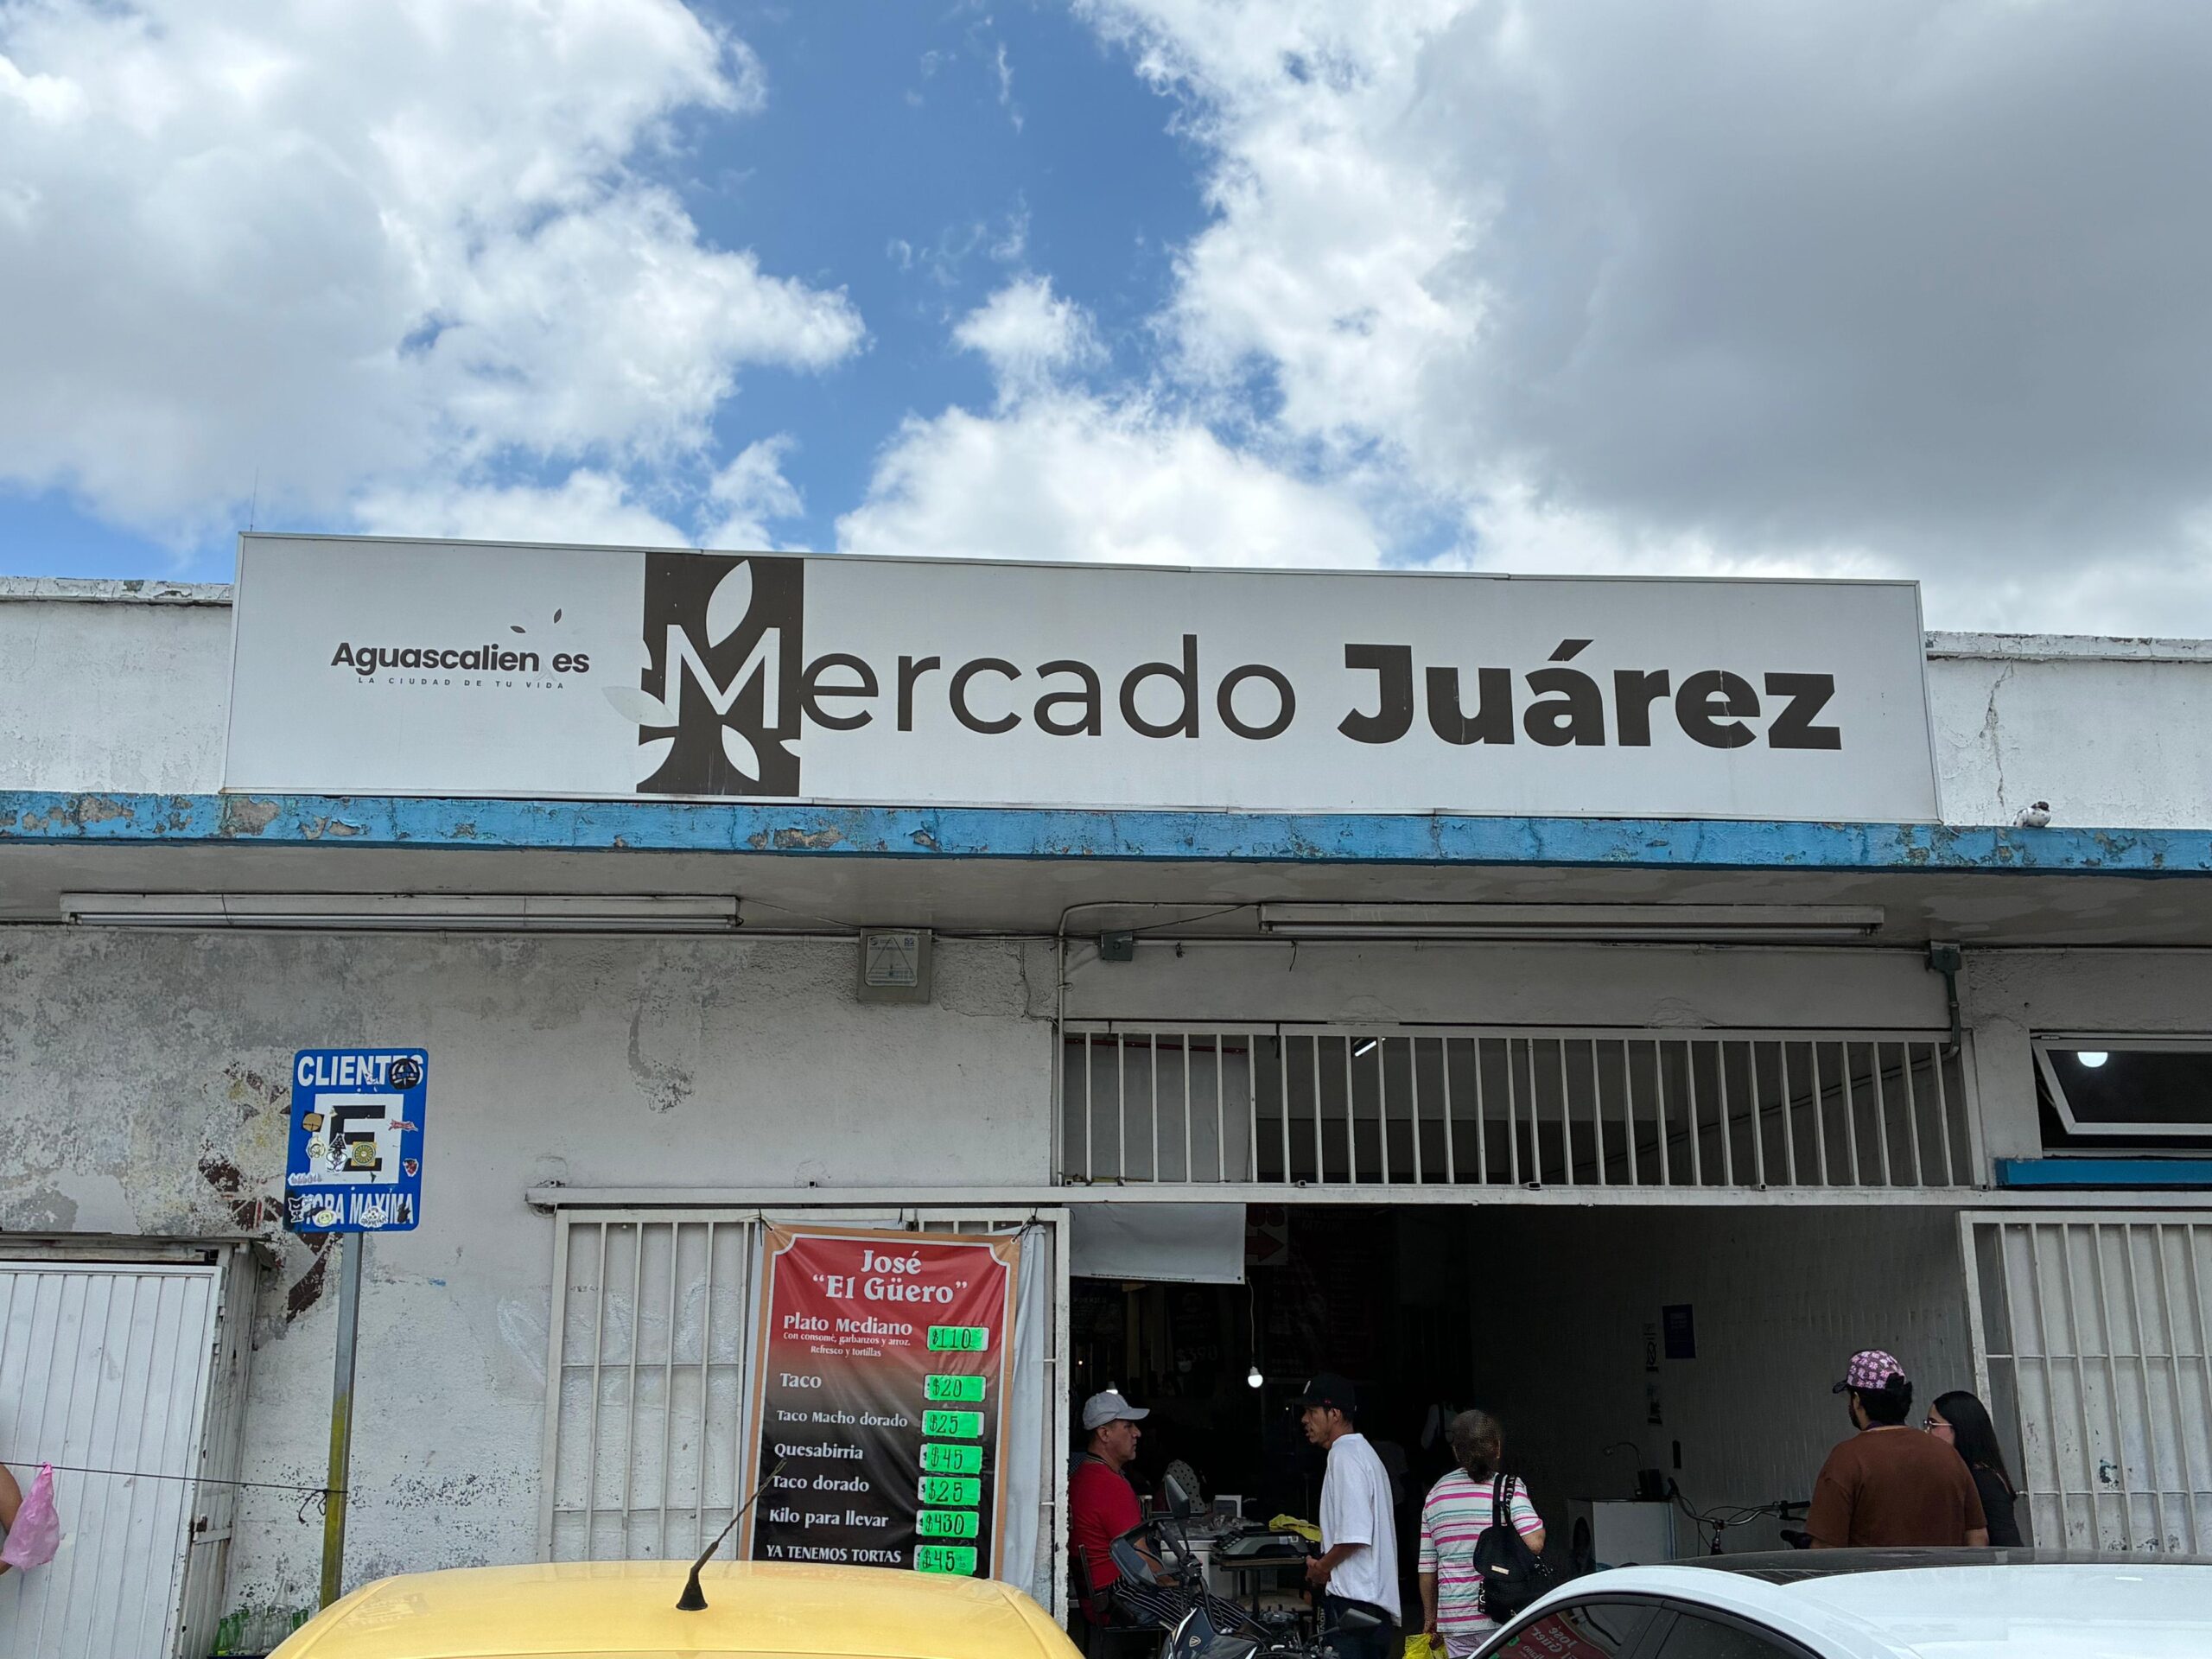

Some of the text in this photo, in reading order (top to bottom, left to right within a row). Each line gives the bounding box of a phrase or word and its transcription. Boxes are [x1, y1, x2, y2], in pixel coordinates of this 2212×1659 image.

[331, 642, 590, 676] Aguascalienes
[664, 624, 1842, 750] Mercado Juárez
[861, 1250, 922, 1274] José
[784, 1312, 913, 1335] Plato Mediano
[839, 1335, 880, 1345] garbanzos
[881, 1338, 886, 1347] y
[933, 1328, 971, 1349] $110
[810, 1344, 881, 1357] Refresco y tortillas
[779, 1372, 822, 1389] Taco
[932, 1377, 962, 1397] $20
[777, 1410, 908, 1427] Taco Macho dorado
[929, 1414, 959, 1434] $25
[774, 1443, 863, 1459] Quesabirria
[931, 1446, 963, 1470] $45
[772, 1475, 869, 1492] Taco dorado
[928, 1479, 963, 1503] $25
[769, 1510, 888, 1529] Kilo para llevar
[766, 1544, 902, 1563] YA TENEMOS TORTAS
[923, 1548, 955, 1572] $45
